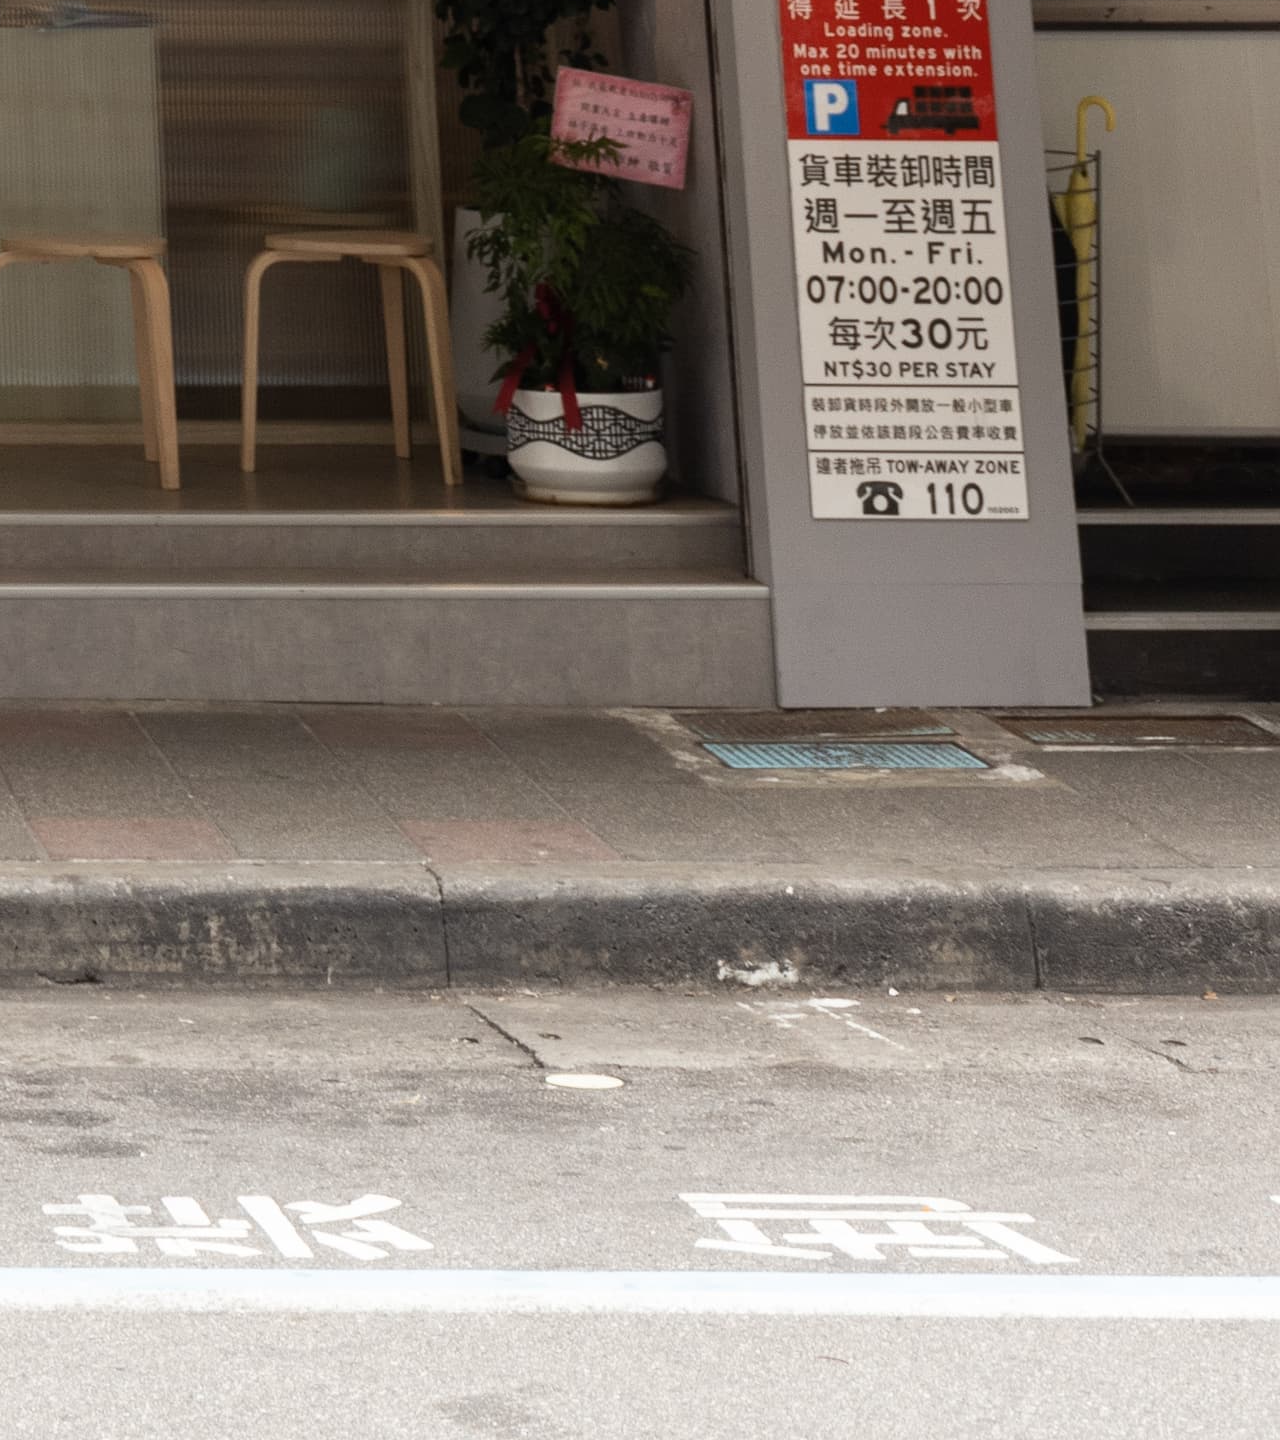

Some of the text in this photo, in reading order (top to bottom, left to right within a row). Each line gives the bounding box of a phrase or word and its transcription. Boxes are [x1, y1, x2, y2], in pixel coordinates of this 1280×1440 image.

[824, 22, 948, 41] Loading zone.
[793, 44, 982, 60] Max 20 minutes with
[800, 62, 978, 77] one time extension.
[813, 82, 849, 132] P
[799, 153, 995, 188] 貨車裝卸時間
[804, 197, 997, 234] 週一至週五
[822, 241, 896, 264] Mon.
[927, 241, 983, 265] Fri.
[806, 275, 1003, 305] 07:00-20:00
[828, 316, 989, 350] 每次30元
[824, 360, 996, 379] NT$30 PER STAY
[812, 397, 1013, 414] 裝卸貨時段外開放一般小型車
[816, 457, 1020, 475] 違者拖吊 TOW-AWAY ZONE
[927, 482, 984, 515] 110
